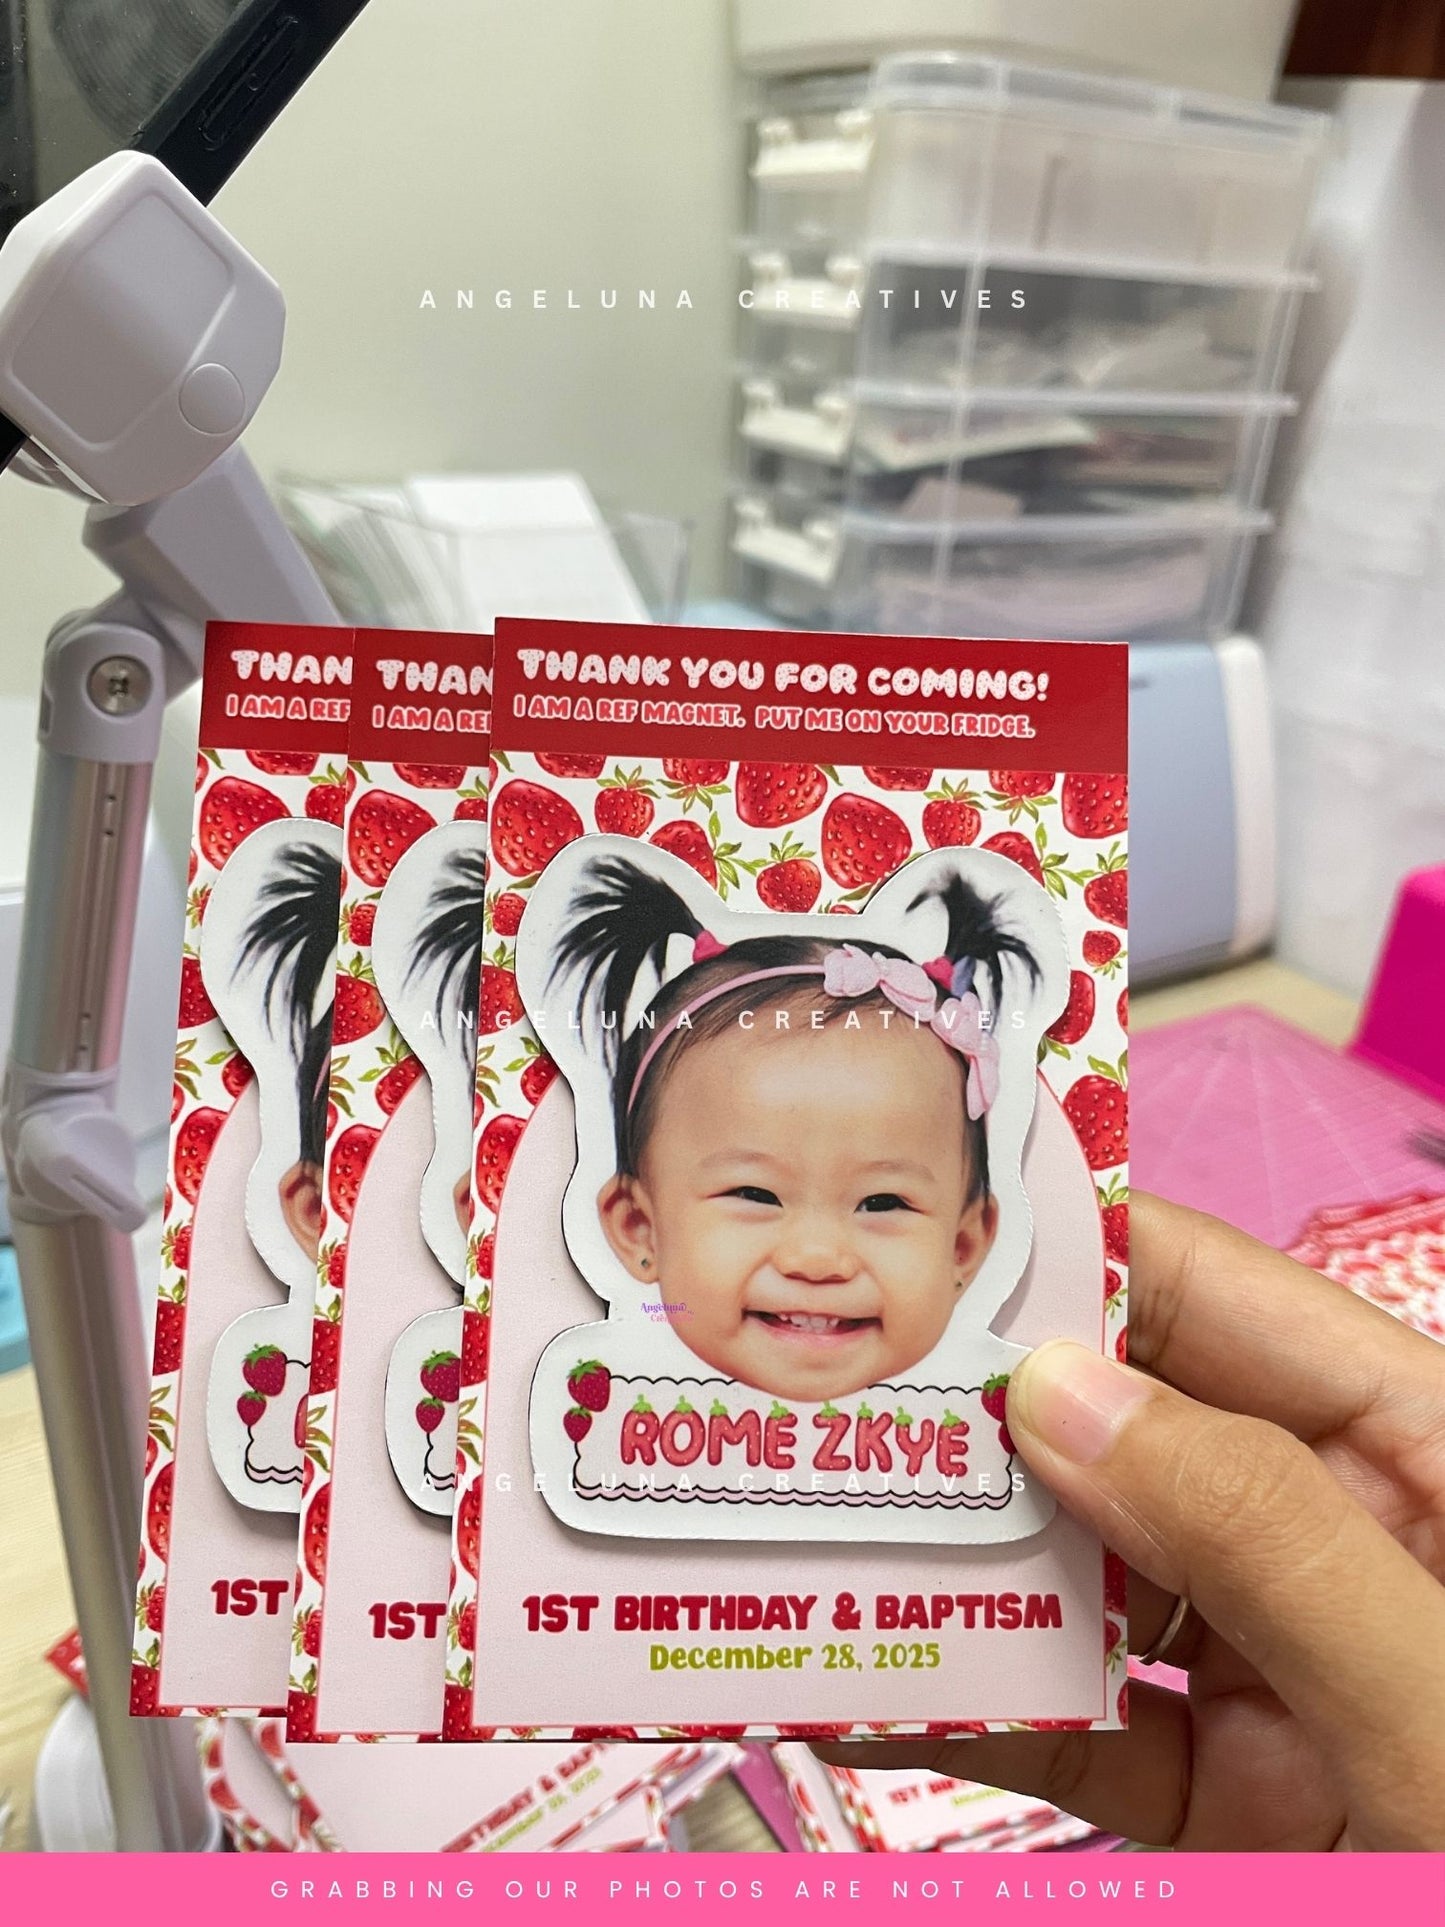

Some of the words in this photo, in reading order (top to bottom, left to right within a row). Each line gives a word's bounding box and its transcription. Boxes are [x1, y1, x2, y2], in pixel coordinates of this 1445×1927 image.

[230, 650, 353, 685] THAN
[517, 649, 671, 686] THANK
[680, 656, 764, 690] YOU
[775, 662, 857, 695] FOR
[868, 667, 1049, 701] COMING!
[226, 693, 238, 717] I
[240, 694, 285, 719] AM
[286, 696, 307, 720] A
[309, 698, 350, 722] REF
[372, 704, 384, 728] I
[387, 705, 431, 731] AM
[433, 708, 454, 732] A
[514, 694, 526, 717] I
[528, 694, 571, 720] AM
[573, 696, 593, 721] A
[596, 698, 638, 723] REF
[641, 700, 746, 728] MAGNET.
[755, 705, 802, 730] PUT
[804, 707, 843, 732] ME
[845, 709, 882, 733] ON
[884, 710, 949, 735] YOUR
[951, 713, 1036, 738] FRIDGE.
[620, 1395, 798, 1470] ROME
[812, 1402, 970, 1477] ZKYE
[211, 1579, 289, 1616] 1ST
[522, 1594, 599, 1633] 1ST
[614, 1594, 818, 1632] BIRTHDAY
[831, 1591, 861, 1631] &
[875, 1592, 1063, 1630] BAPTISM
[368, 1601, 447, 1640] 1ST
[649, 1643, 813, 1671] December
[821, 1643, 863, 1672] 28,
[871, 1643, 941, 1670] 2025
